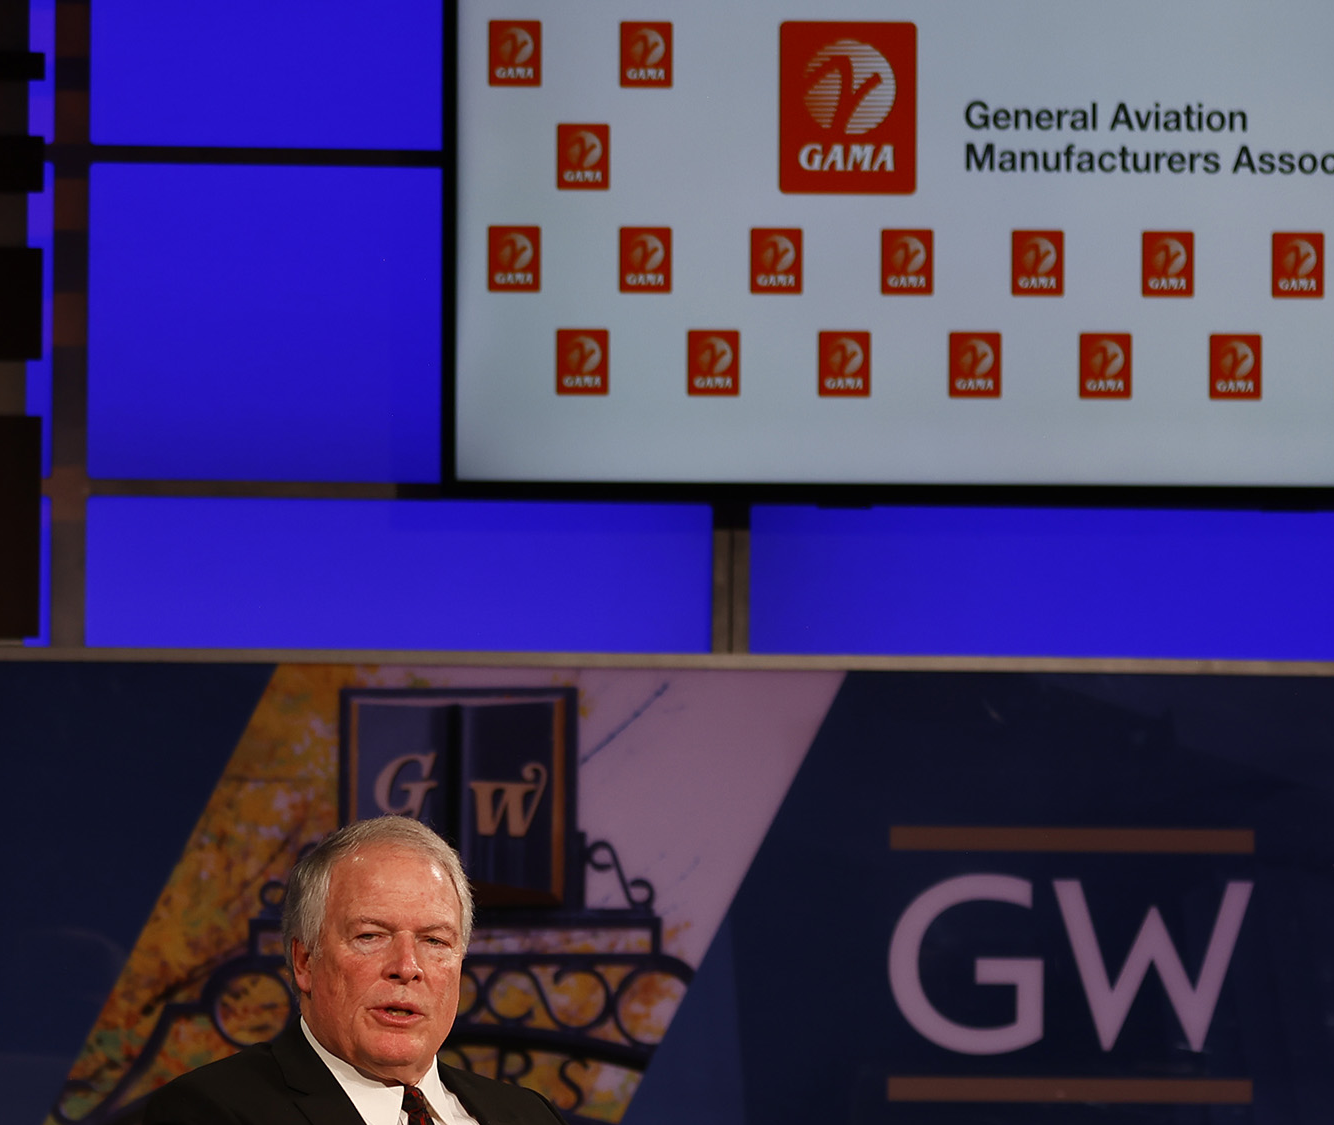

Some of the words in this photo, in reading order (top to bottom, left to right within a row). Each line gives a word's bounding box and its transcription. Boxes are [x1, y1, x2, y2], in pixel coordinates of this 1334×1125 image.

[494, 66, 534, 79] GAMA
[626, 67, 666, 81] GAMA
[965, 101, 1097, 131] General
[1110, 102, 1248, 133] Aviation
[798, 143, 895, 172] GAMA
[965, 143, 1220, 174] Manufacturers
[562, 169, 603, 183] GAMA
[494, 271, 534, 285] GAMA
[625, 272, 665, 286] GAMA
[756, 273, 796, 287] GAMA
[887, 274, 926, 288] GAMA
[1017, 275, 1057, 289] GAMA
[1148, 276, 1187, 290] GAMA
[1278, 277, 1317, 291] GAMA
[562, 374, 602, 388] GAMA
[693, 375, 733, 389] GAMA
[824, 376, 864, 390] GAMA
[954, 377, 994, 391] GAMA
[1085, 378, 1125, 392] GAMA
[1215, 379, 1254, 393] GAMA
[887, 872, 1255, 1056] GW
